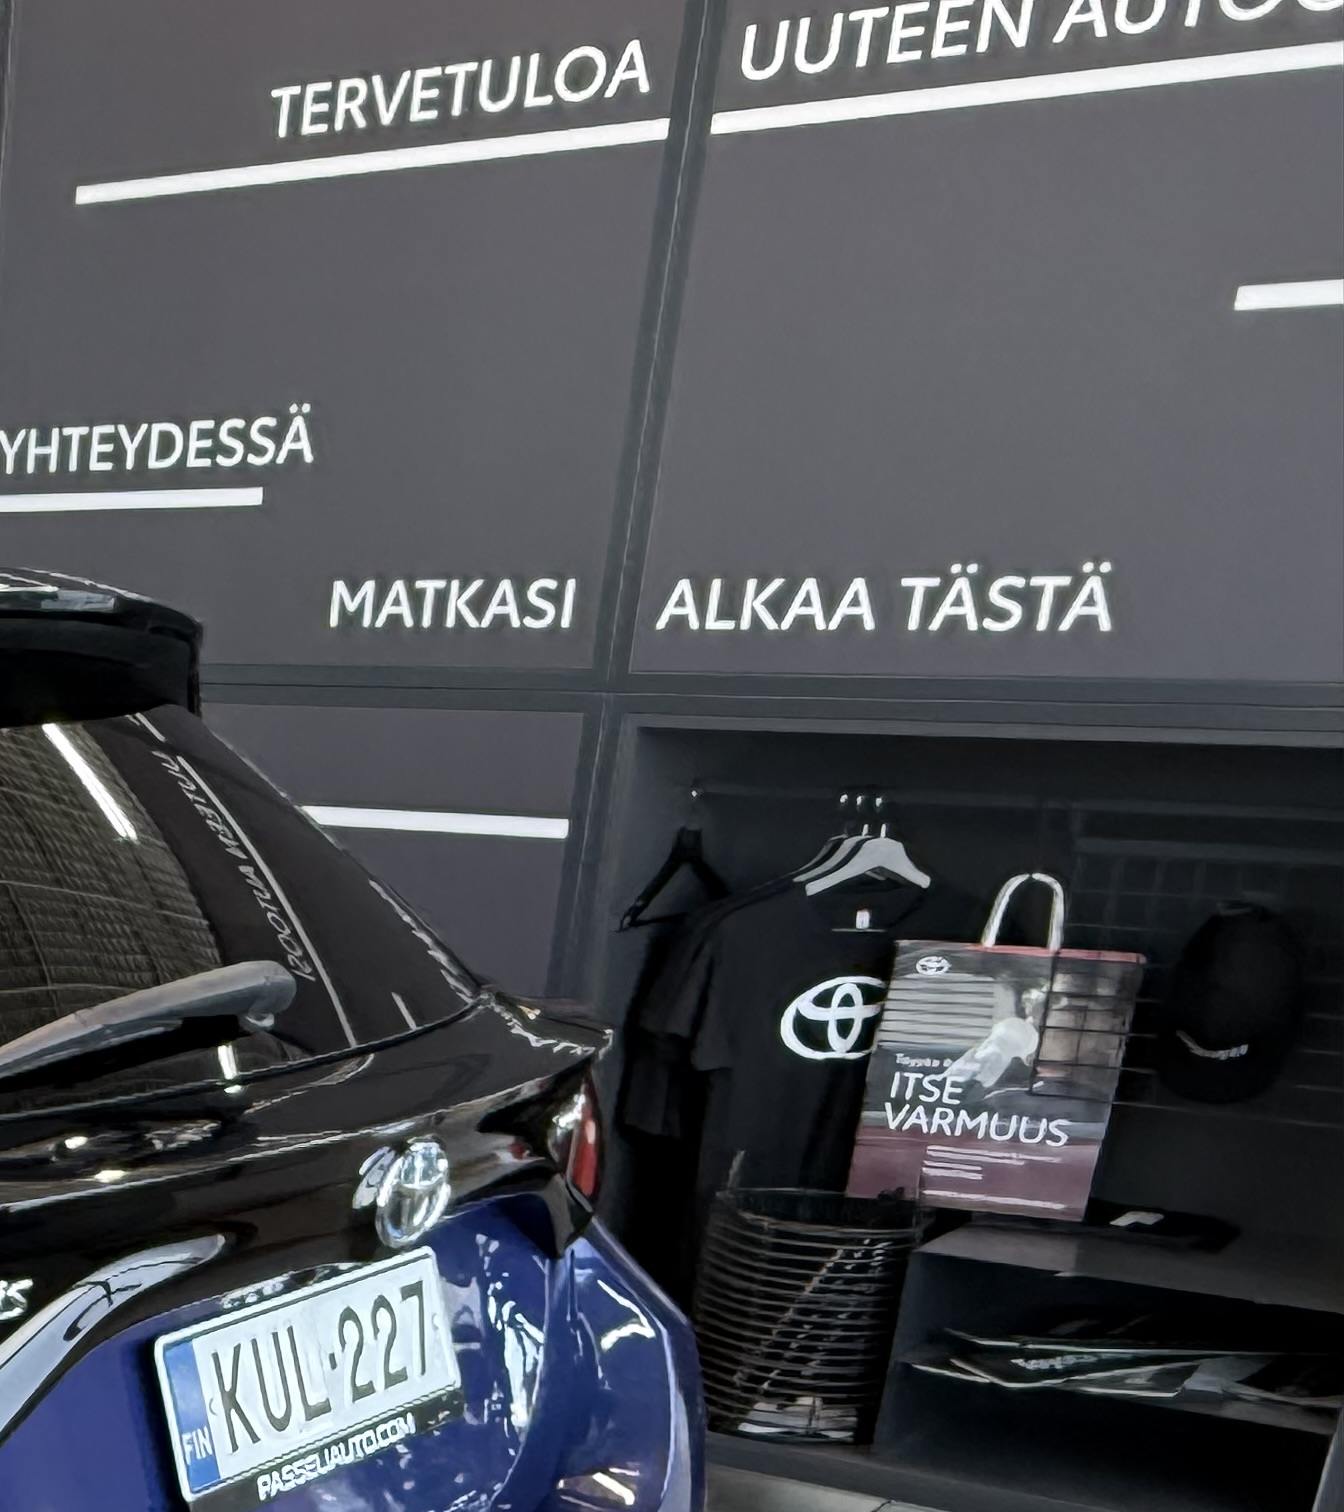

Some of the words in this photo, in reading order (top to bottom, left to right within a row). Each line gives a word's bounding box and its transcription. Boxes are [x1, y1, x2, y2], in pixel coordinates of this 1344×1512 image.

[270, 39, 651, 139] TERVETULOA
[740, 0, 1030, 81] UUTEEN
[329, 578, 577, 629] MATKASI
[655, 577, 876, 631] ALKAA
[900, 561, 1113, 633] TÄSTÄ
[890, 1071, 963, 1105] ITSE
[885, 1101, 1069, 1147] VARMUUS
[211, 1279, 427, 1454] KUL-227
[182, 1426, 214, 1466] FIN
